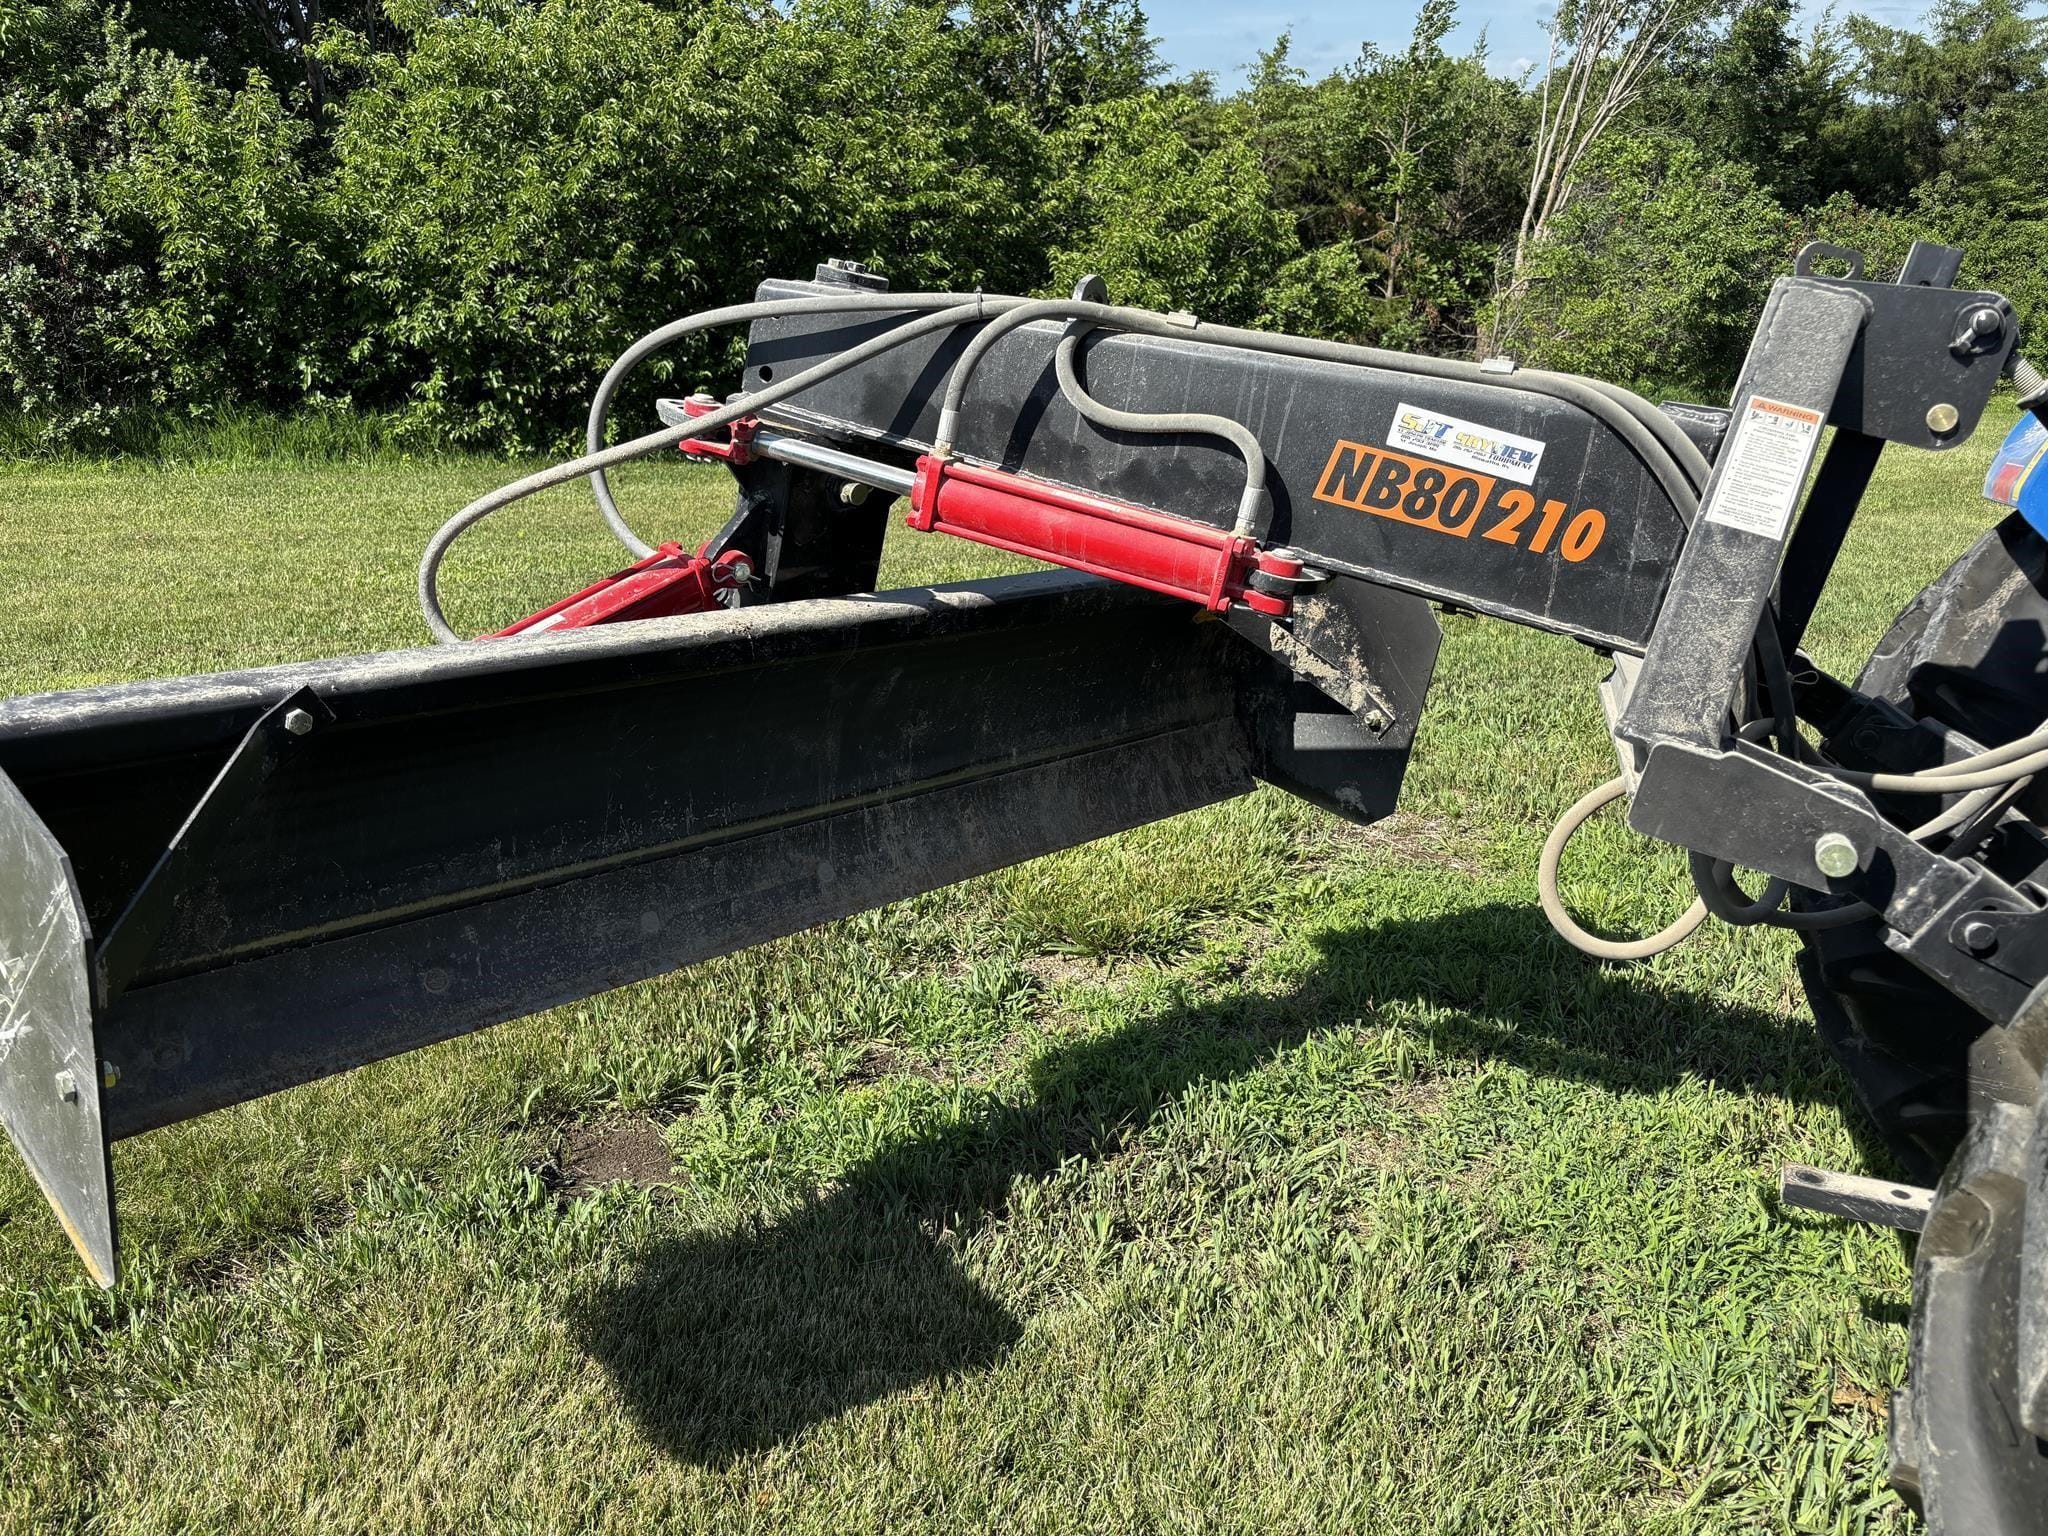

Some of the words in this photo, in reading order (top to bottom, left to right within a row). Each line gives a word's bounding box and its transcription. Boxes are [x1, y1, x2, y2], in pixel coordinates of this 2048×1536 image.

[1767, 404, 1813, 421] WARNING
[1322, 447, 1480, 528] NB80
[1481, 489, 1606, 563] 210
